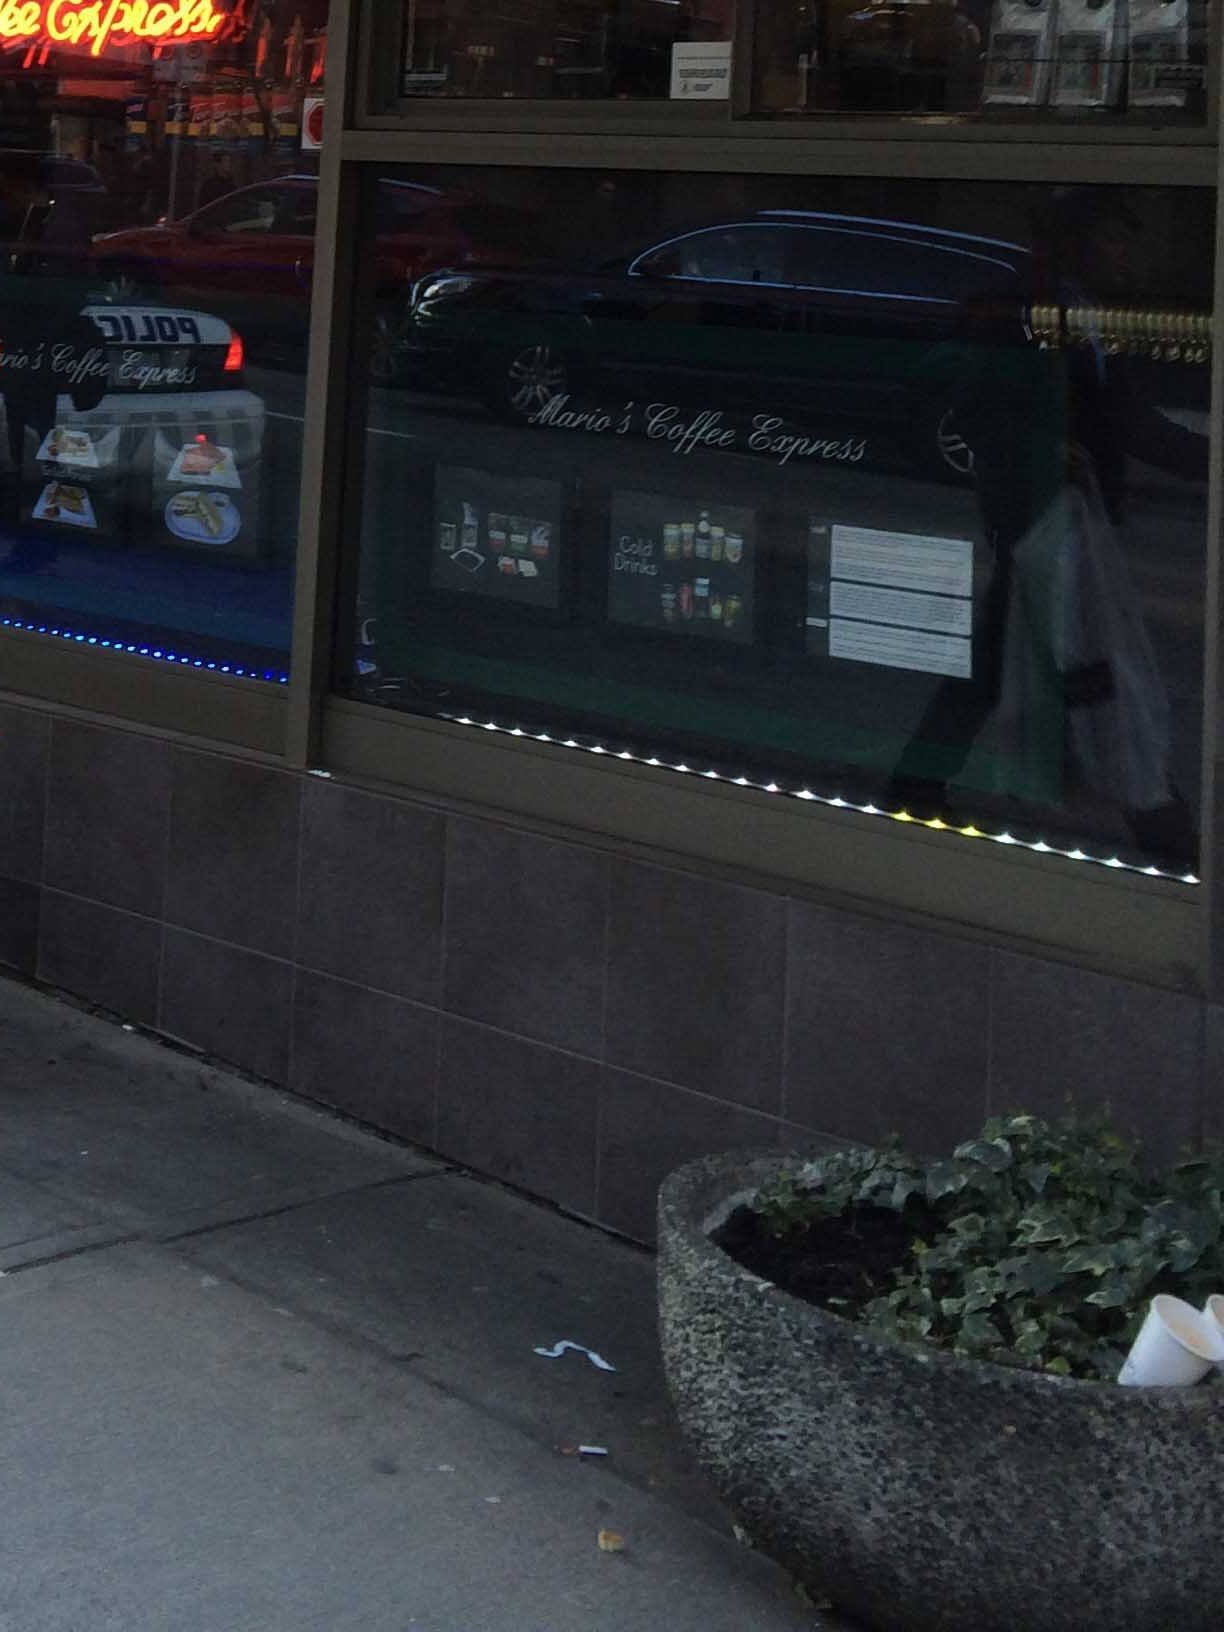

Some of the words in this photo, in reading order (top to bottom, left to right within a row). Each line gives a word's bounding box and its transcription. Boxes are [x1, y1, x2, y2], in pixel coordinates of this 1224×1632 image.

[51, 344, 111, 382] Coffee
[119, 350, 197, 390] Express
[528, 393, 634, 435] Mario's
[645, 403, 736, 456] Coffee
[748, 414, 868, 466] Express
